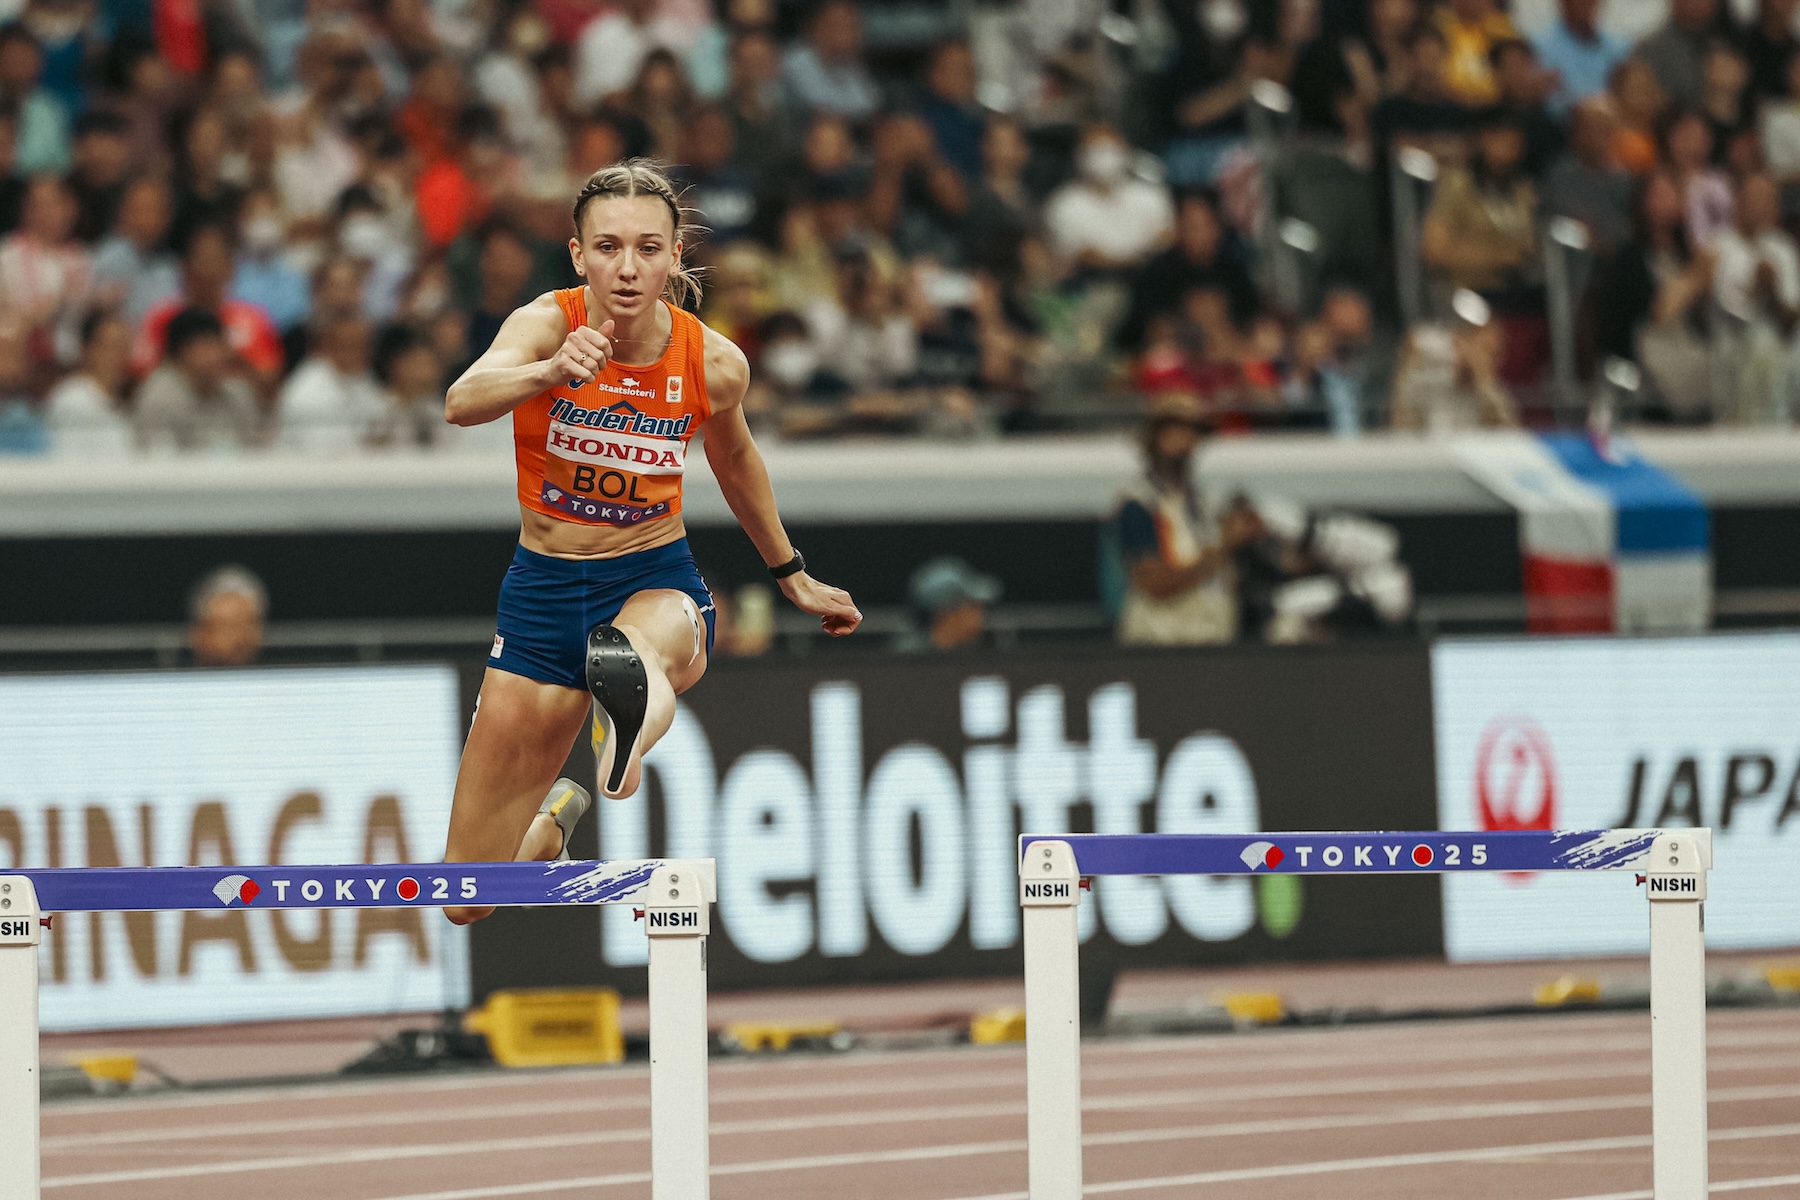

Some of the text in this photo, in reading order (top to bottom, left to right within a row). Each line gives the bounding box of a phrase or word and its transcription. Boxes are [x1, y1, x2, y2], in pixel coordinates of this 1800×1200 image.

[598, 383, 656, 399] Staatsloterij
[550, 430, 682, 467] HONDA
[573, 465, 648, 502] BOL
[1025, 884, 1069, 897] NISHI
[1651, 878, 1696, 892] NISHI
[650, 912, 697, 927] NISHI
